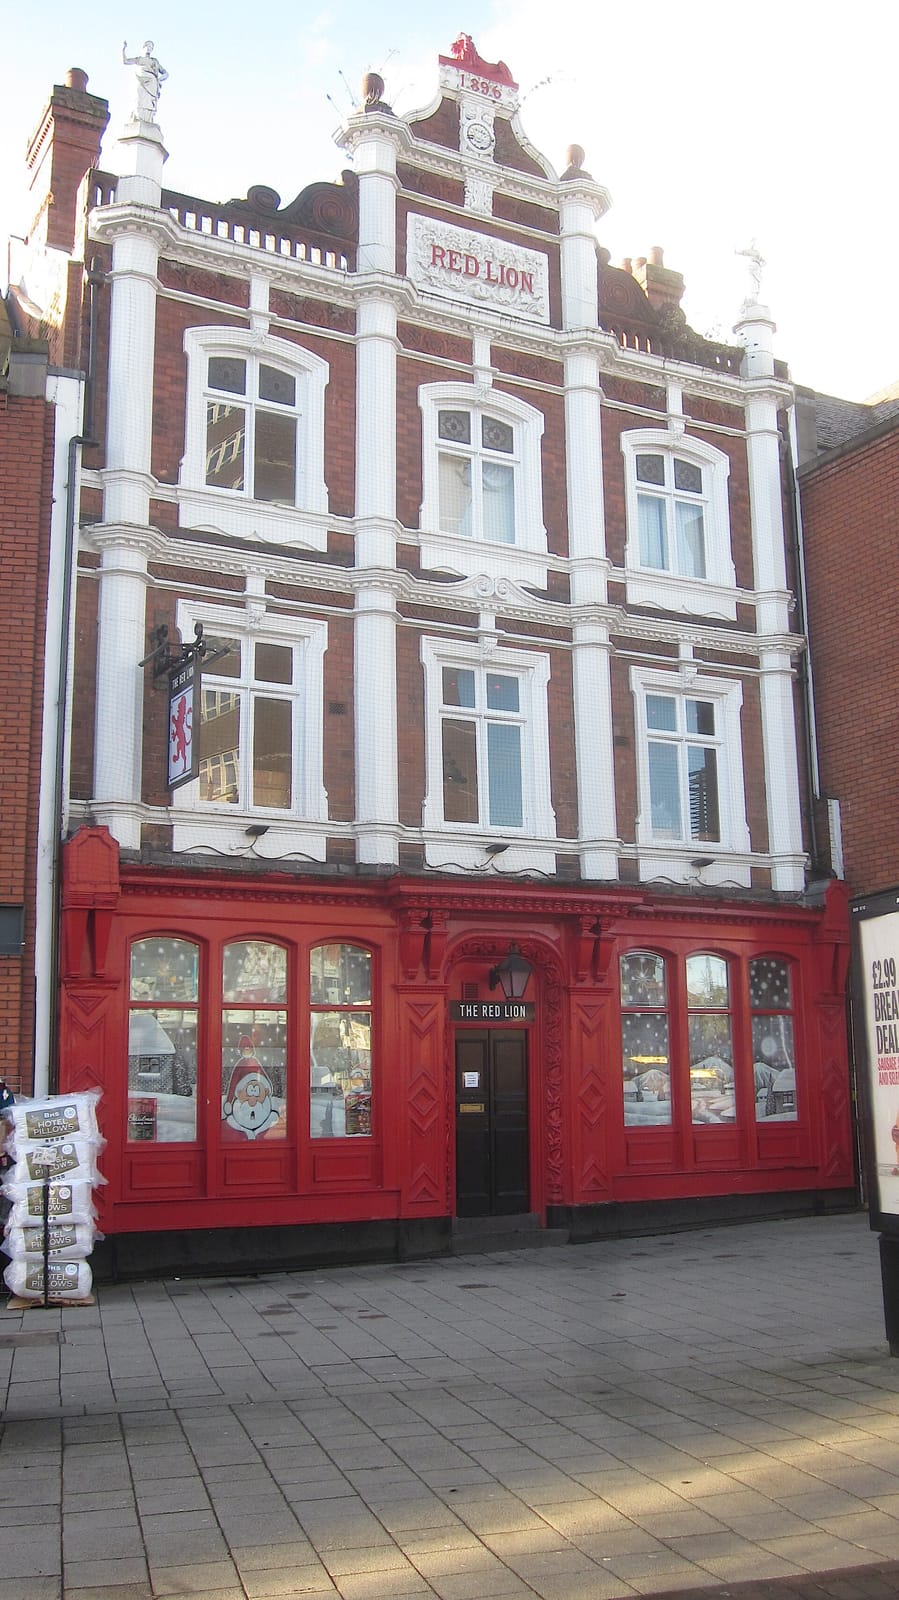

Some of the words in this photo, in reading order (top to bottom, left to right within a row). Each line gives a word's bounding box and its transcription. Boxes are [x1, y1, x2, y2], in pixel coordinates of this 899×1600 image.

[461, 74, 501, 99] 1896
[431, 244, 480, 279] RED
[485, 261, 534, 294] LION
[872, 957, 896, 990] £2.99
[459, 1004, 479, 1017] THE
[482, 1004, 501, 1017] RED
[504, 1004, 527, 1018] LION
[873, 990, 899, 1022] BREA
[876, 1023, 899, 1055] DEAL
[878, 1072, 889, 1087] AND
[33, 1124, 75, 1136] PILLOWS
[38, 1119, 69, 1128] HOTEL
[39, 1197, 62, 1205] HTEL
[31, 1237, 72, 1249] PILOWS
[36, 1231, 65, 1241] HTEL
[31, 1280, 73, 1288] PILOWS
